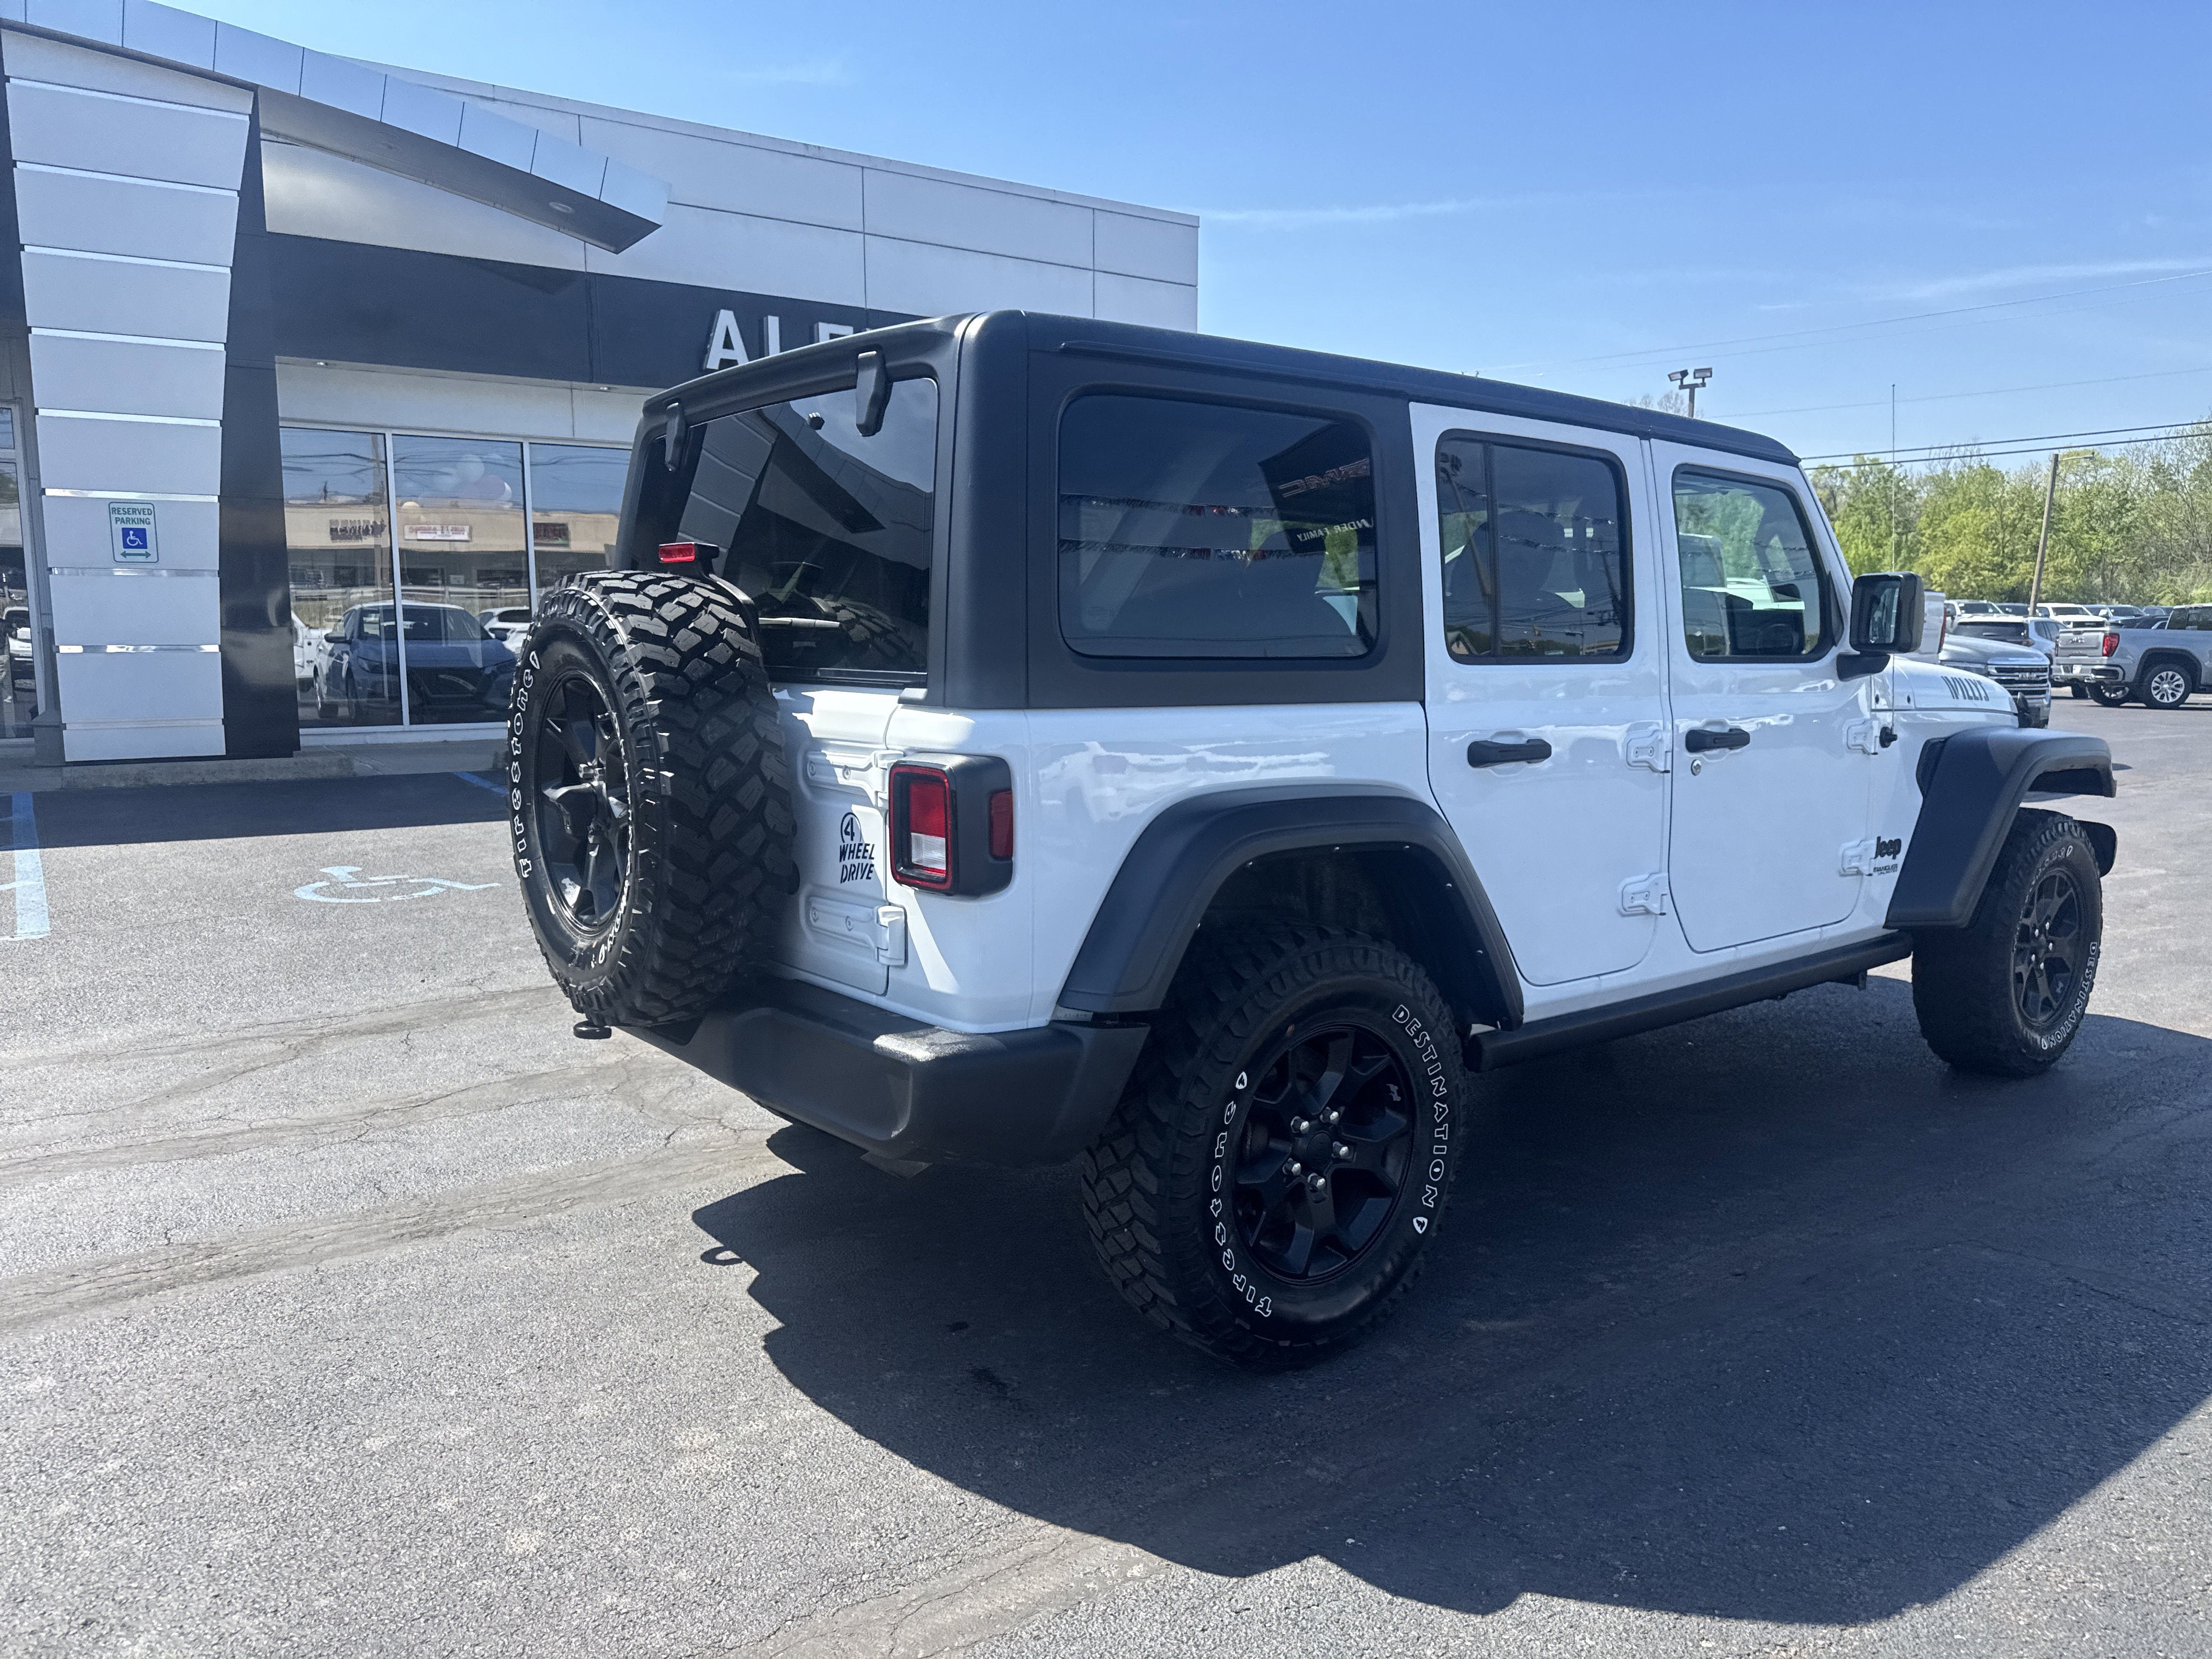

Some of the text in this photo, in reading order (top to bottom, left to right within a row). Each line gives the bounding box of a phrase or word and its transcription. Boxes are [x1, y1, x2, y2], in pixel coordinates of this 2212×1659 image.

[111, 507, 153, 516] RESERVED
[115, 517, 151, 525] PARKING
[1941, 675, 1989, 702] WILLYS
[844, 817, 855, 841] 4
[839, 843, 875, 862] WHEEL
[1874, 836, 1902, 860] Jeep
[840, 862, 874, 884] DRIVE
[2047, 941, 2098, 1048] DESTINATION
[1392, 1004, 1449, 1208] DESTINATION
